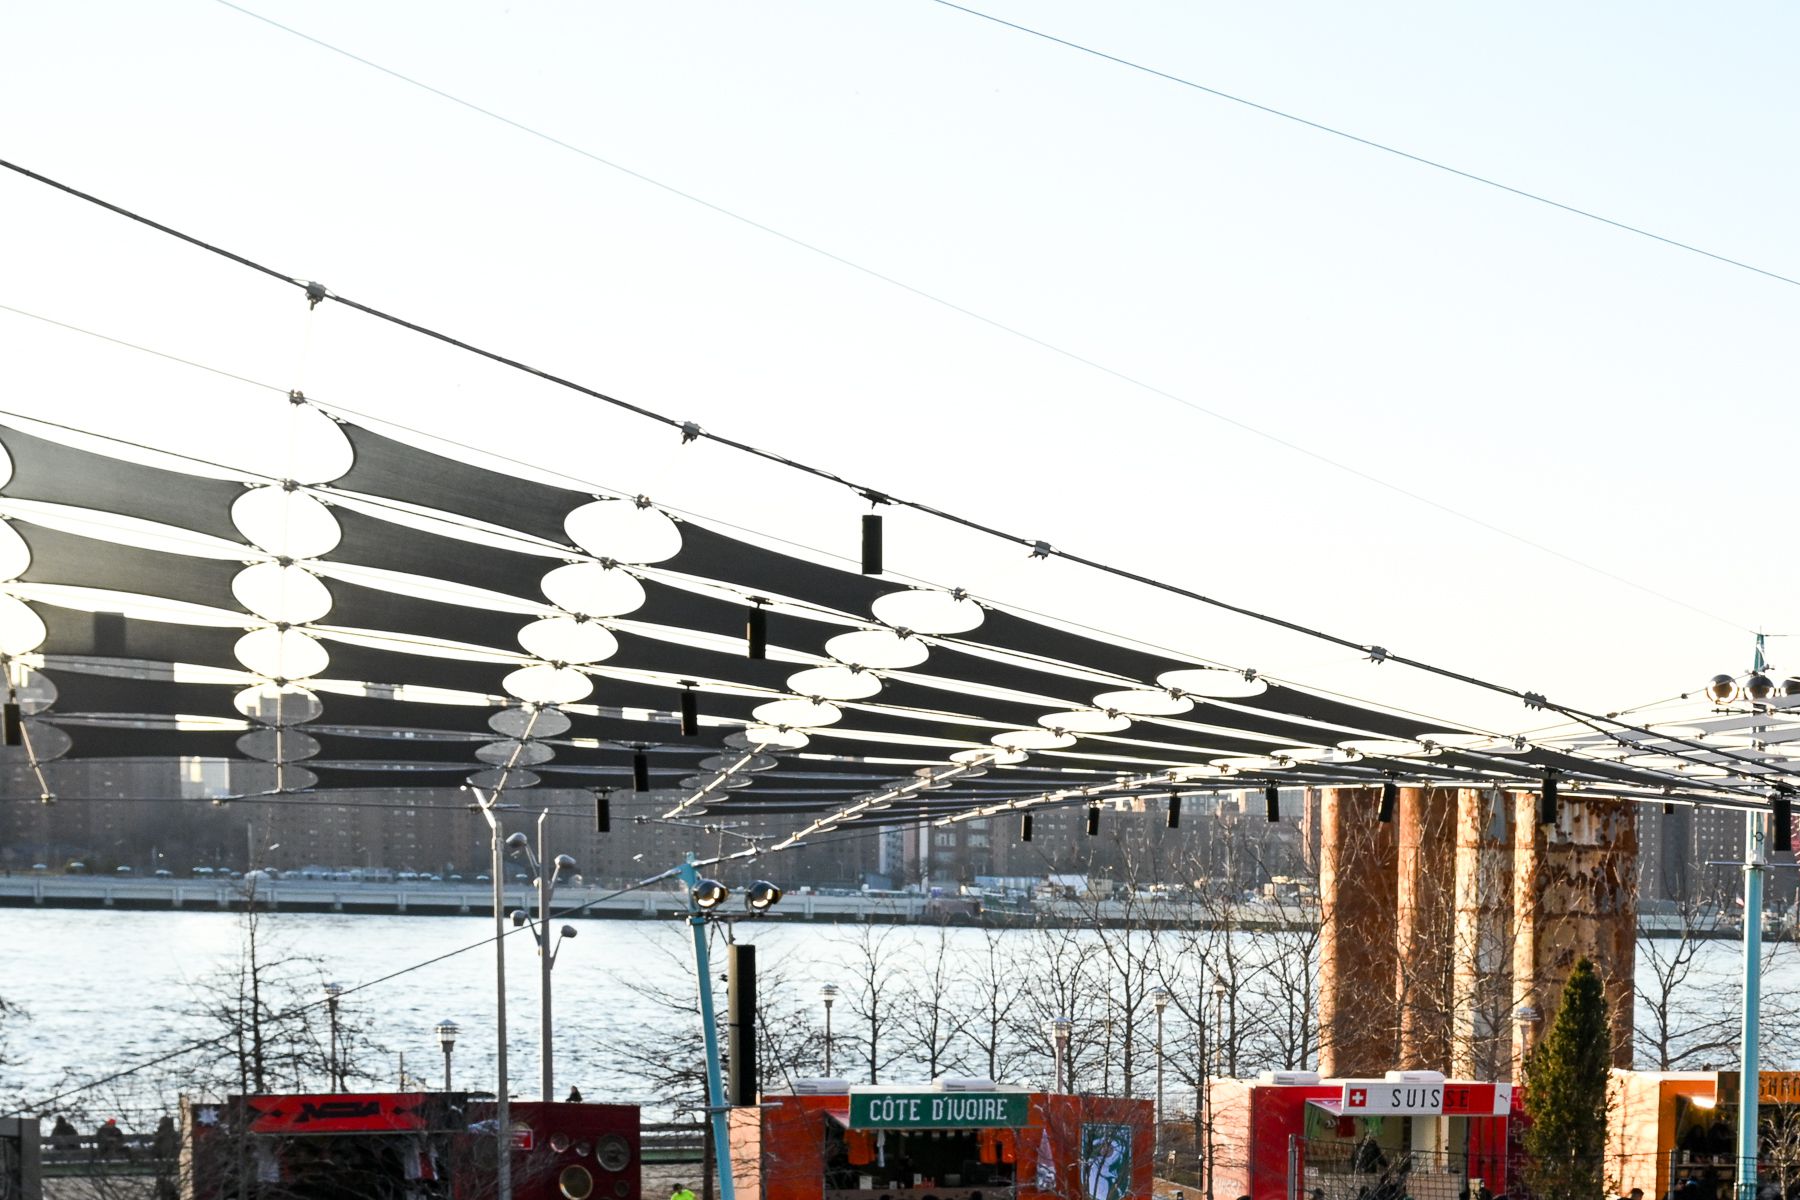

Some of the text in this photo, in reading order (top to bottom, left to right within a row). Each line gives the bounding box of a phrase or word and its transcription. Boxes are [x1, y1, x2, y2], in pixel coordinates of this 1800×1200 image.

[869, 1095, 1008, 1121] CÔTE D'IVOIRE
[1391, 1088, 1470, 1108] SUISSE
